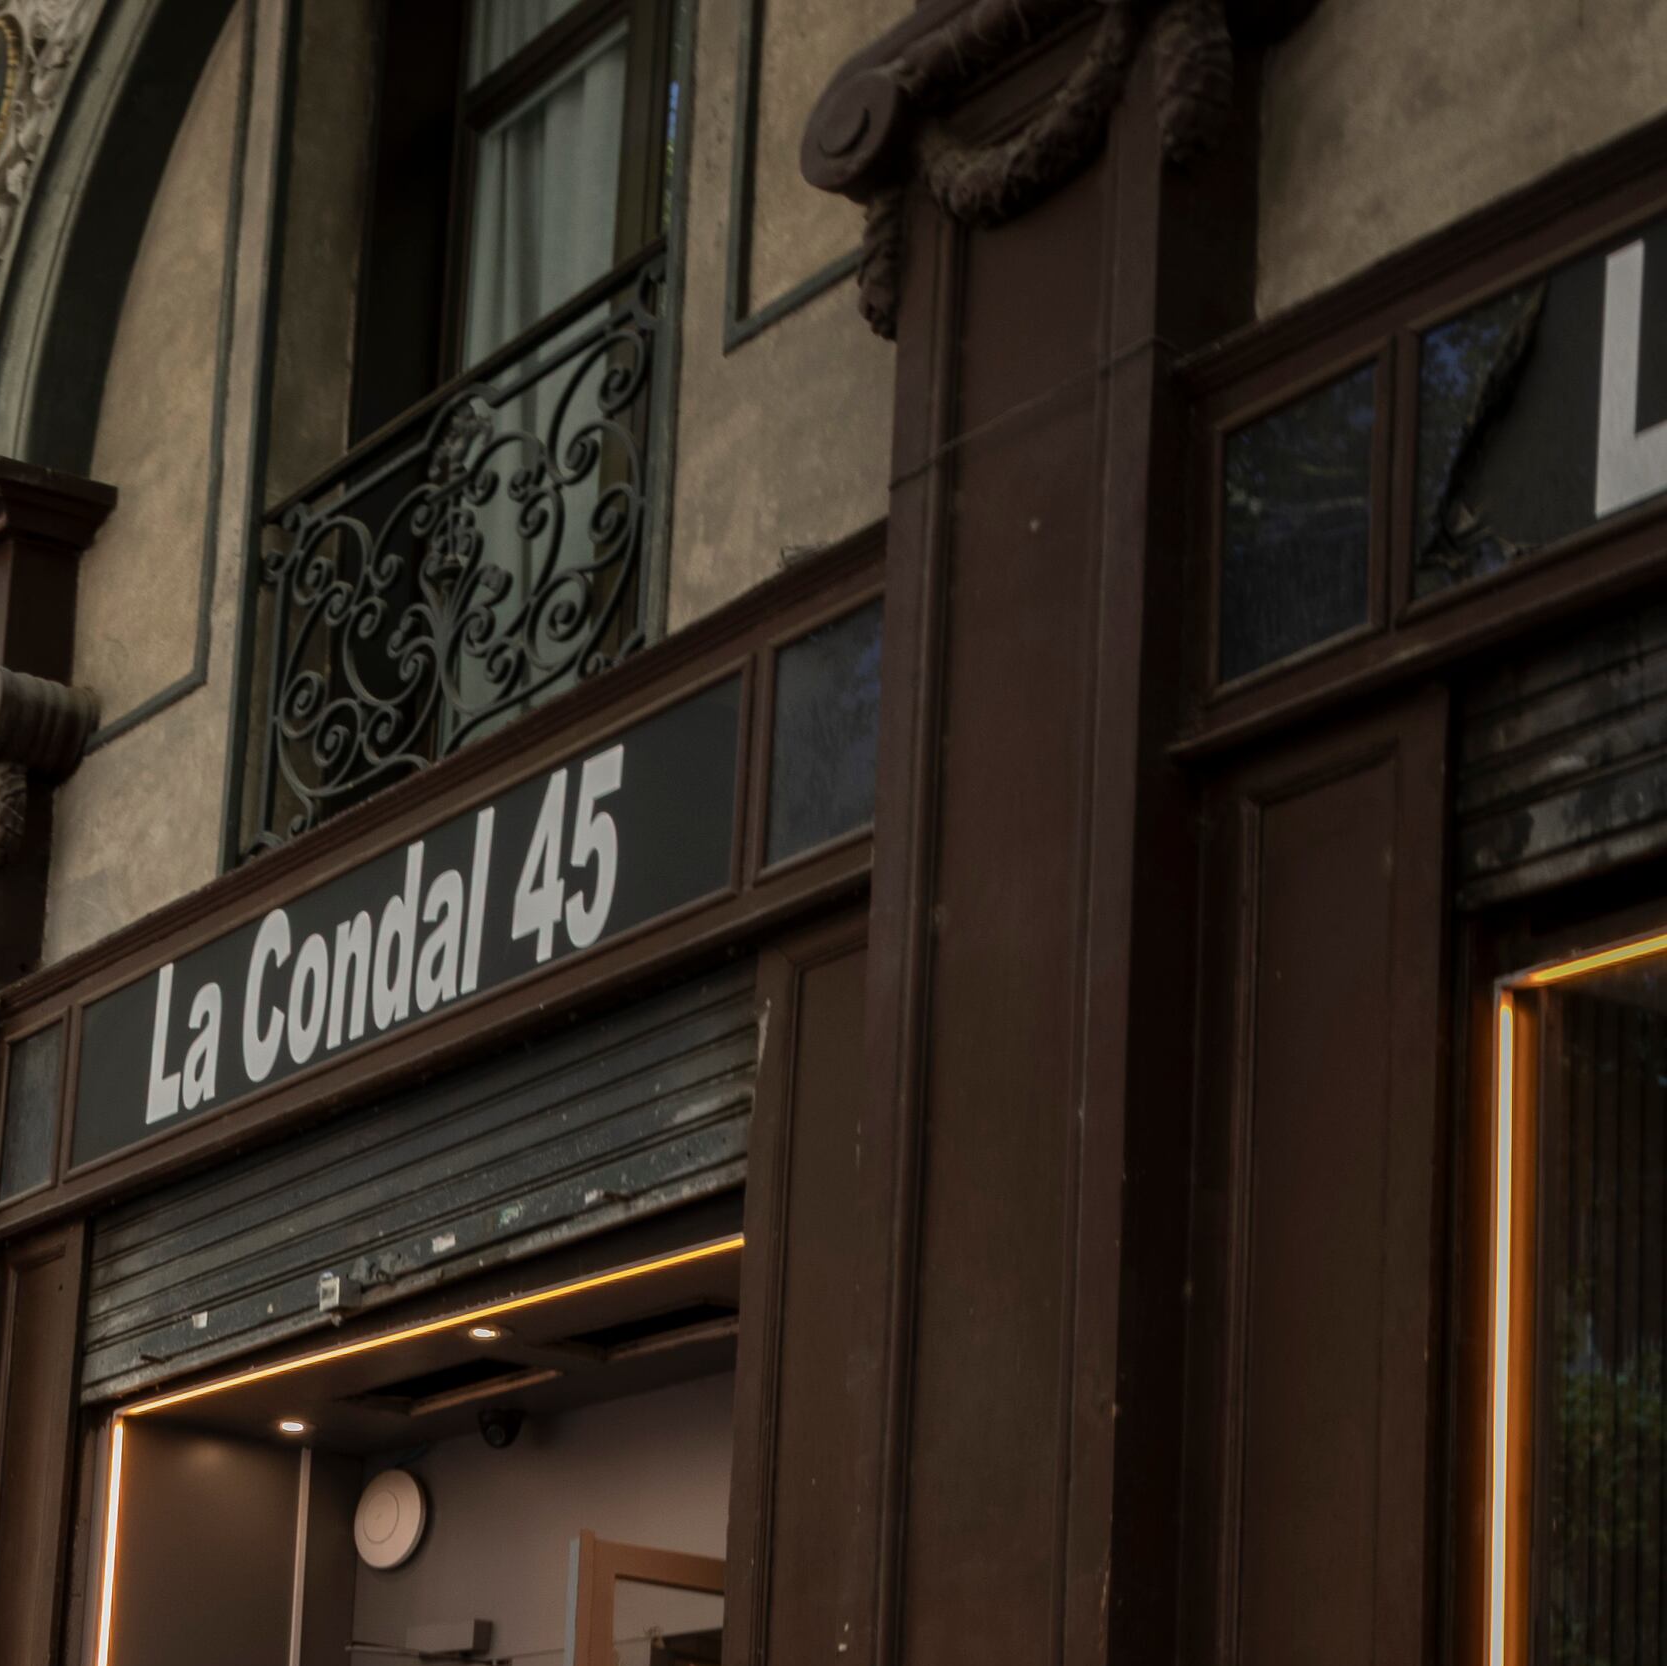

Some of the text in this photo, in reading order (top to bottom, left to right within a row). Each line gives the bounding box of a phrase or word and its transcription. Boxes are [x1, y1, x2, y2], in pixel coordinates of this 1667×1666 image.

[146, 743, 624, 1125] La Condal 45
